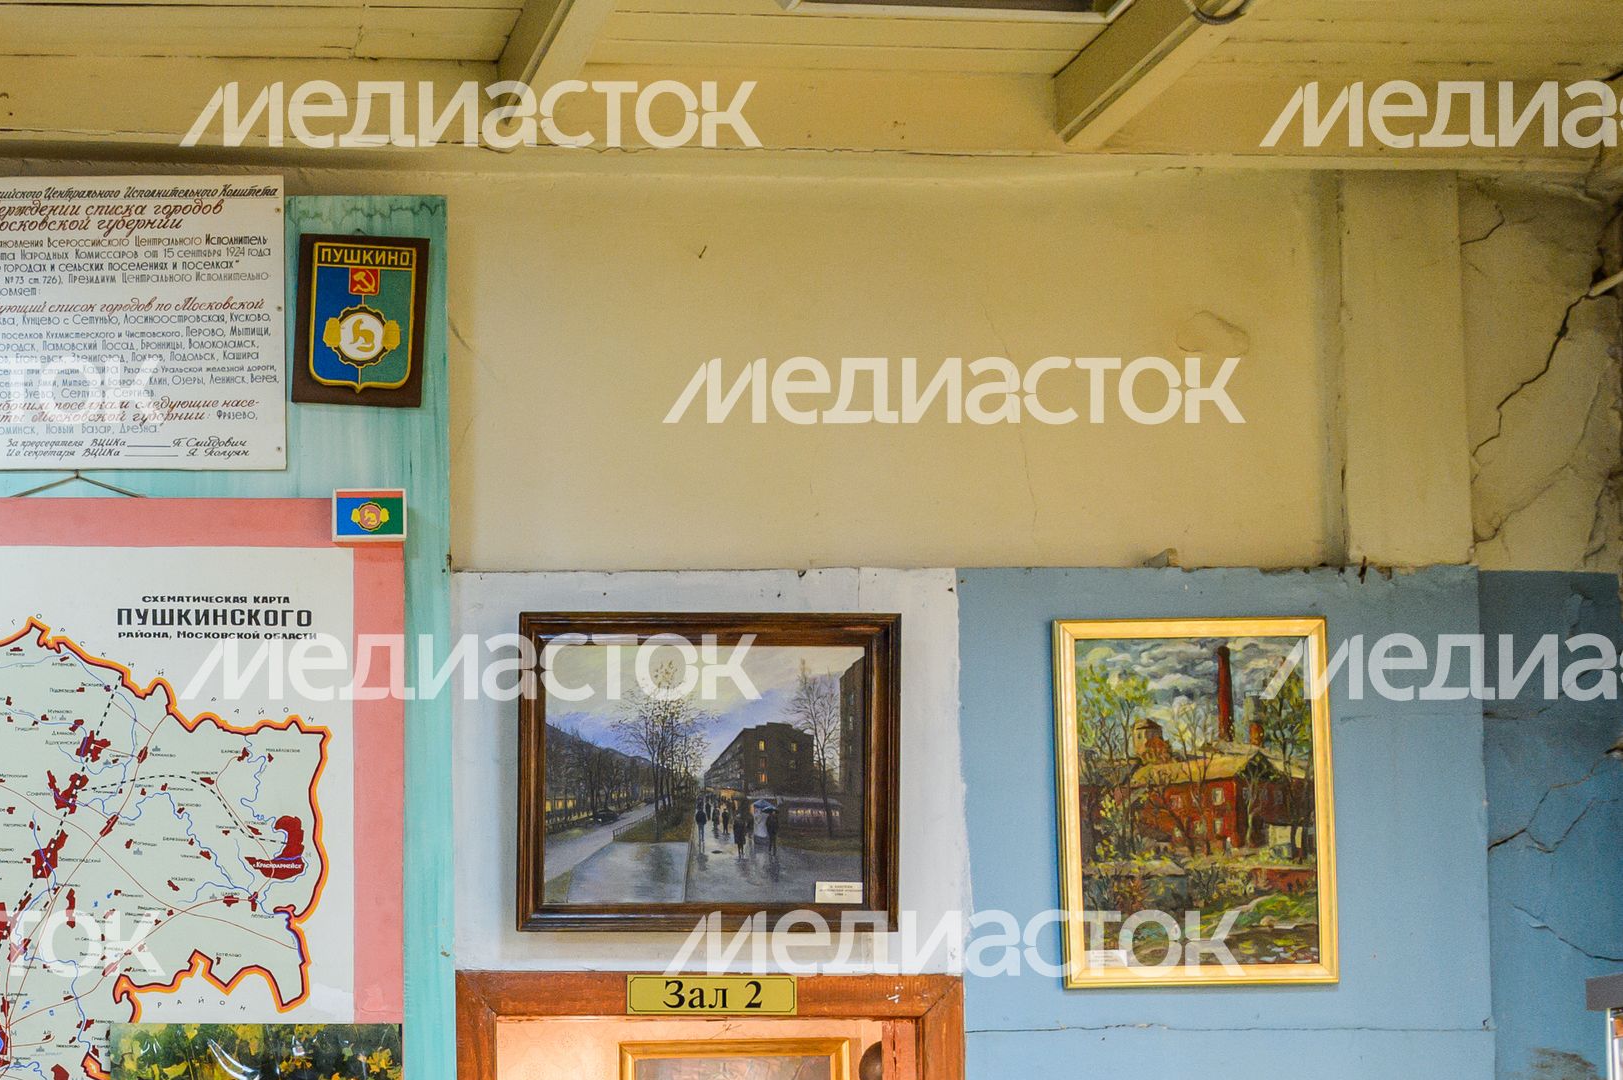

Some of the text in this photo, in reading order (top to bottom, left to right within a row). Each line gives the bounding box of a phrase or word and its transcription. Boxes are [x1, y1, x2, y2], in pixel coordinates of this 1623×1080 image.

[45, 187, 120, 200] Центрального
[124, 187, 218, 199] Исполнительного
[154, 199, 224, 219] городов
[98, 217, 183, 237] губернии
[48, 237, 129, 249] Всероссийского
[135, 236, 202, 247] Центрального
[21, 250, 69, 261] Народных
[75, 249, 138, 260] Комиссаров
[144, 250, 158, 258] от
[164, 248, 174, 258] 15
[226, 247, 245, 257] 1924
[248, 248, 270, 258] года
[321, 248, 410, 266] ПУШКИНО
[4, 264, 46, 273] городах
[51, 264, 55, 272] и
[59, 262, 104, 272] сельских
[108, 260, 168, 271] поселениях
[173, 261, 177, 270] и
[122, 272, 192, 283] Центрального
[49, 303, 95, 314] список
[100, 297, 157, 315] городов
[157, 303, 170, 311] по
[175, 297, 265, 311] Московской
[23, 315, 59, 326] Кунцево
[43, 342, 97, 352] Павловский
[223, 351, 259, 361] Кашира
[142, 596, 290, 604] СХЕМАТИЧЕСКАЯ КАРТА
[117, 608, 312, 627] ПУШКИНСКОГО
[662, 980, 762, 1009] Зал 2
